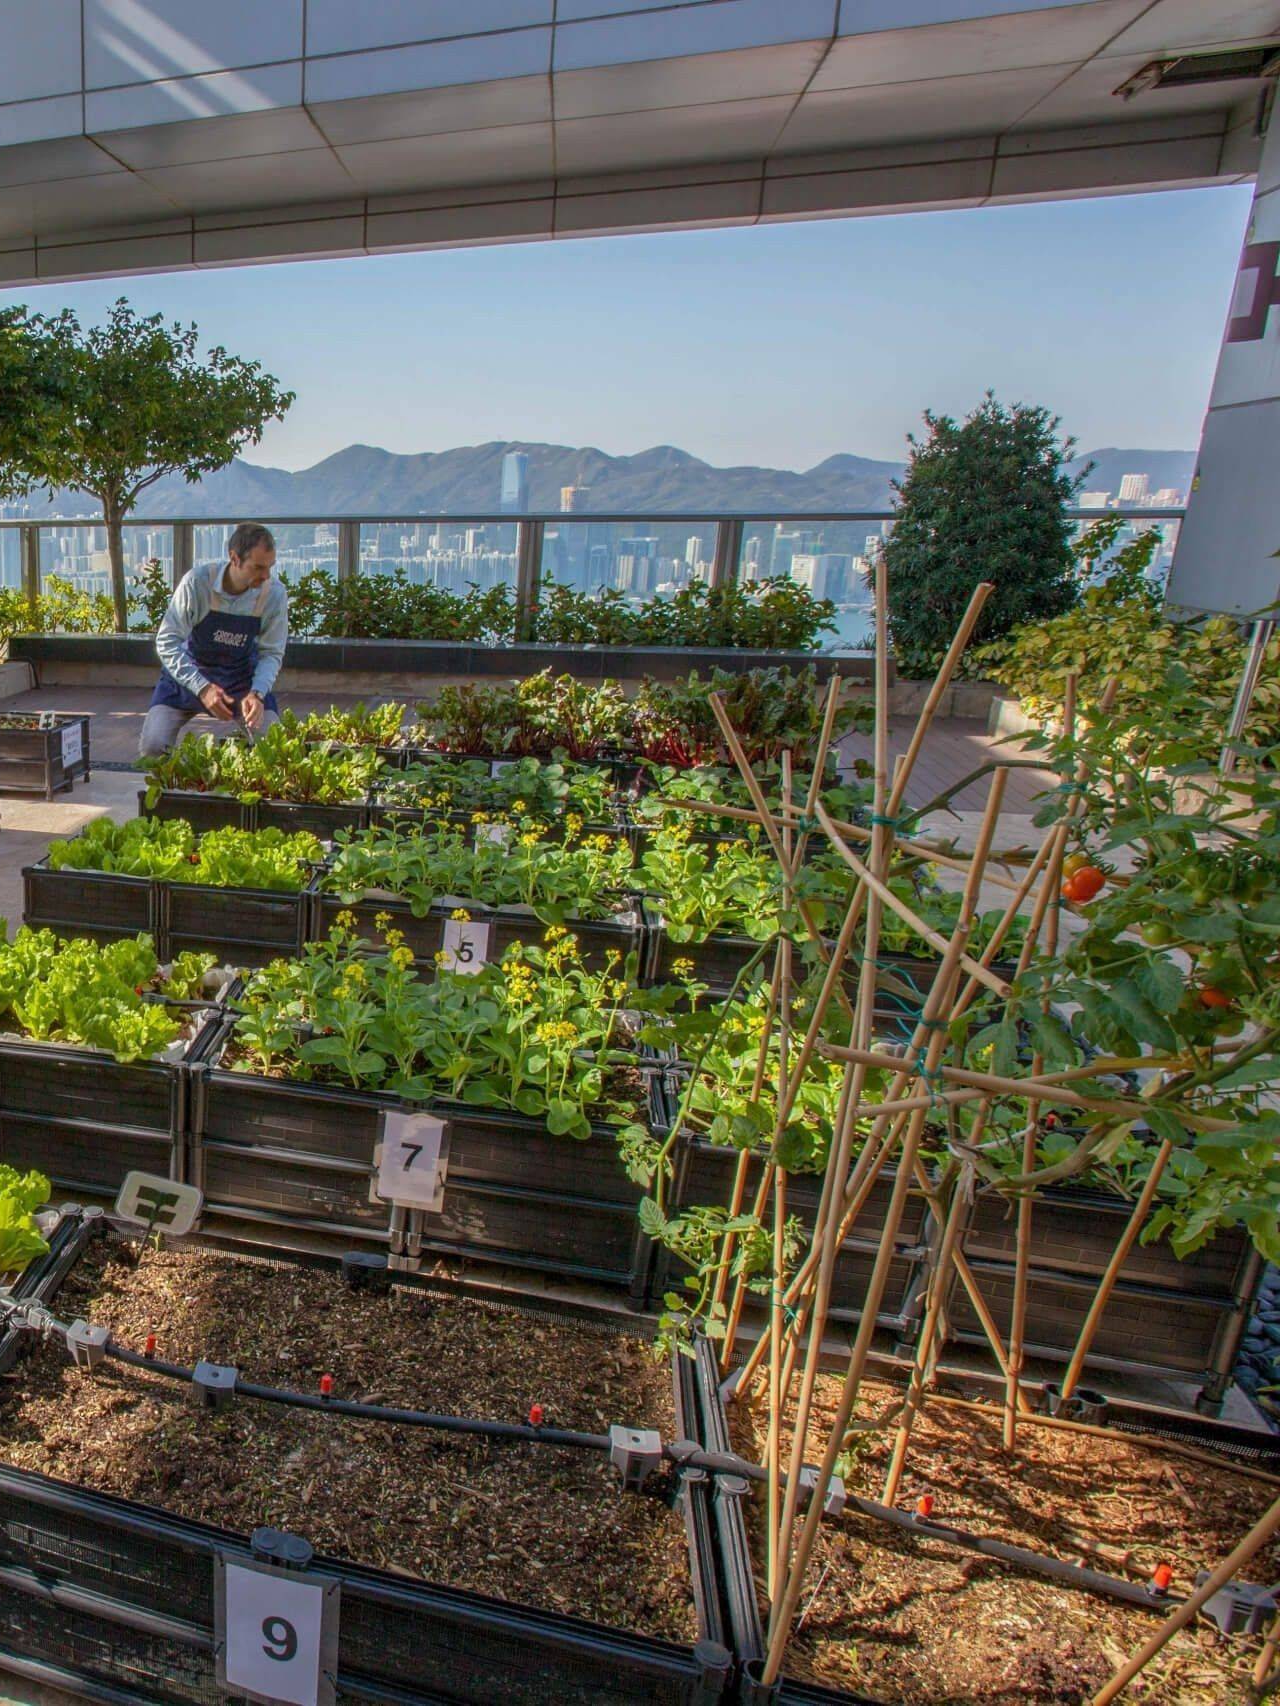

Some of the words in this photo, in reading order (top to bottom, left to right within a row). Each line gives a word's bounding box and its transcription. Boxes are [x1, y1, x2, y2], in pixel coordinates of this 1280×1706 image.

[460, 942, 473, 963] 5
[400, 1142, 423, 1172] 7
[261, 1615, 298, 1662] 9
